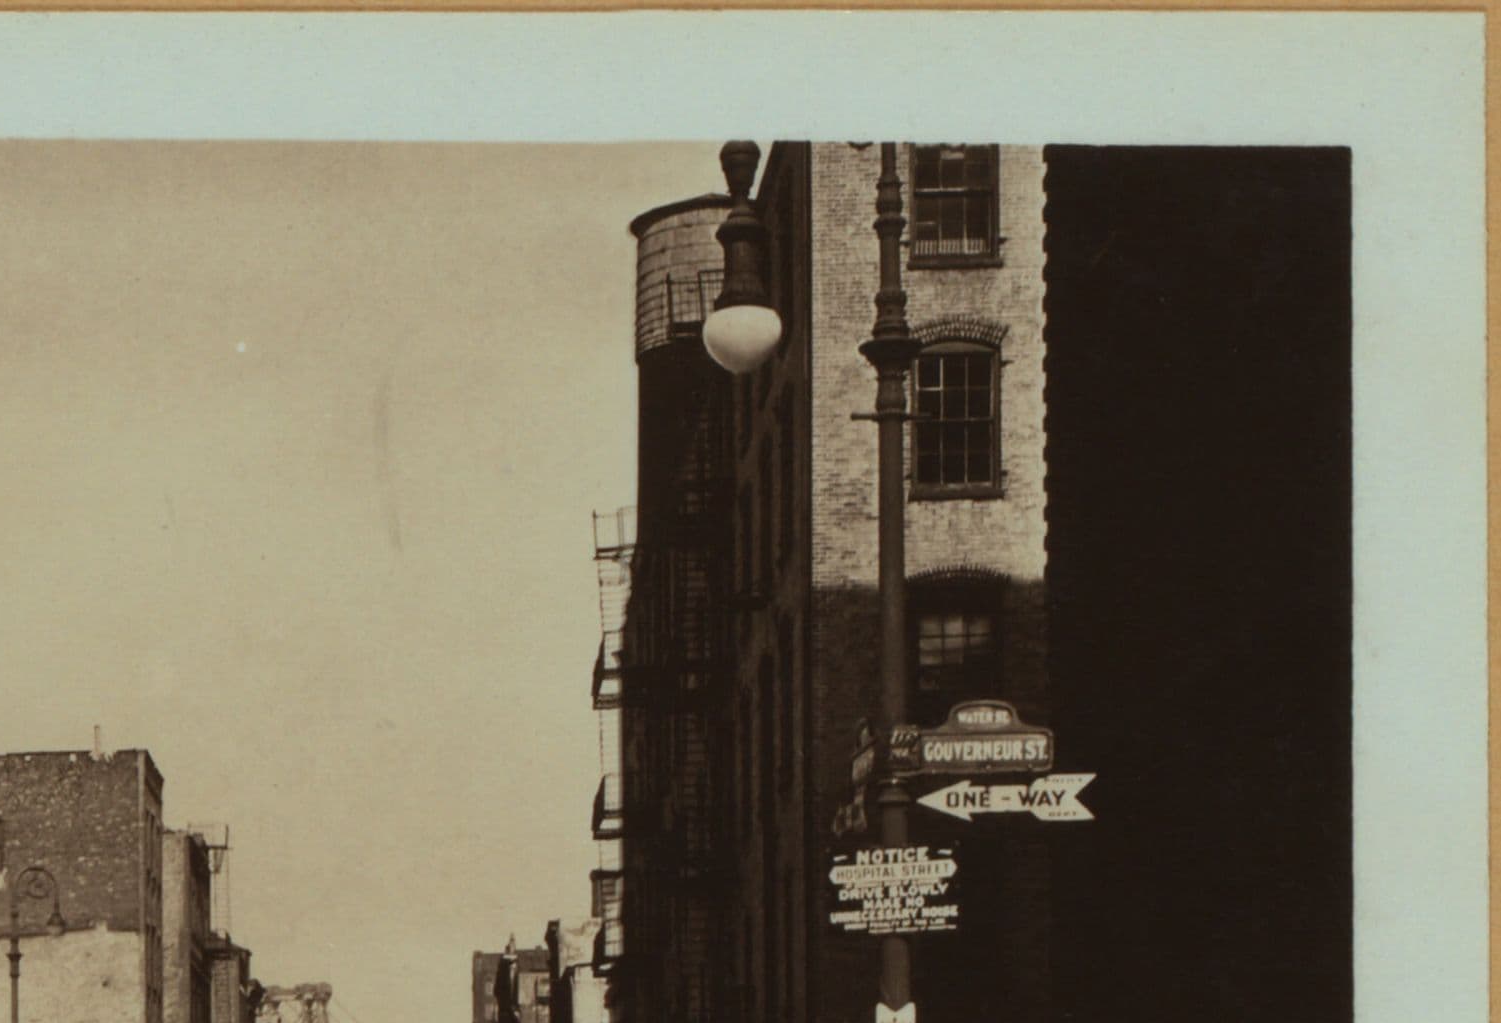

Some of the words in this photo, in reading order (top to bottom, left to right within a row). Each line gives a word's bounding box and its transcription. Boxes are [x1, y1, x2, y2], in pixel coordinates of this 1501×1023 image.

[923, 740, 1023, 761] GOUVERNEUR
[1025, 738, 1049, 760] ST.
[945, 790, 991, 808] ONE
[1018, 790, 1067, 807] WAY
[856, 846, 930, 865] NOTICE
[836, 867, 895, 881] HOSPITAL
[902, 863, 949, 877] STREET
[838, 887, 885, 901] DRIVE
[889, 882, 949, 896] SLOWLY
[863, 896, 902, 910] MAKE
[905, 895, 925, 908] NO
[829, 908, 919, 925] UNNECESSARY
